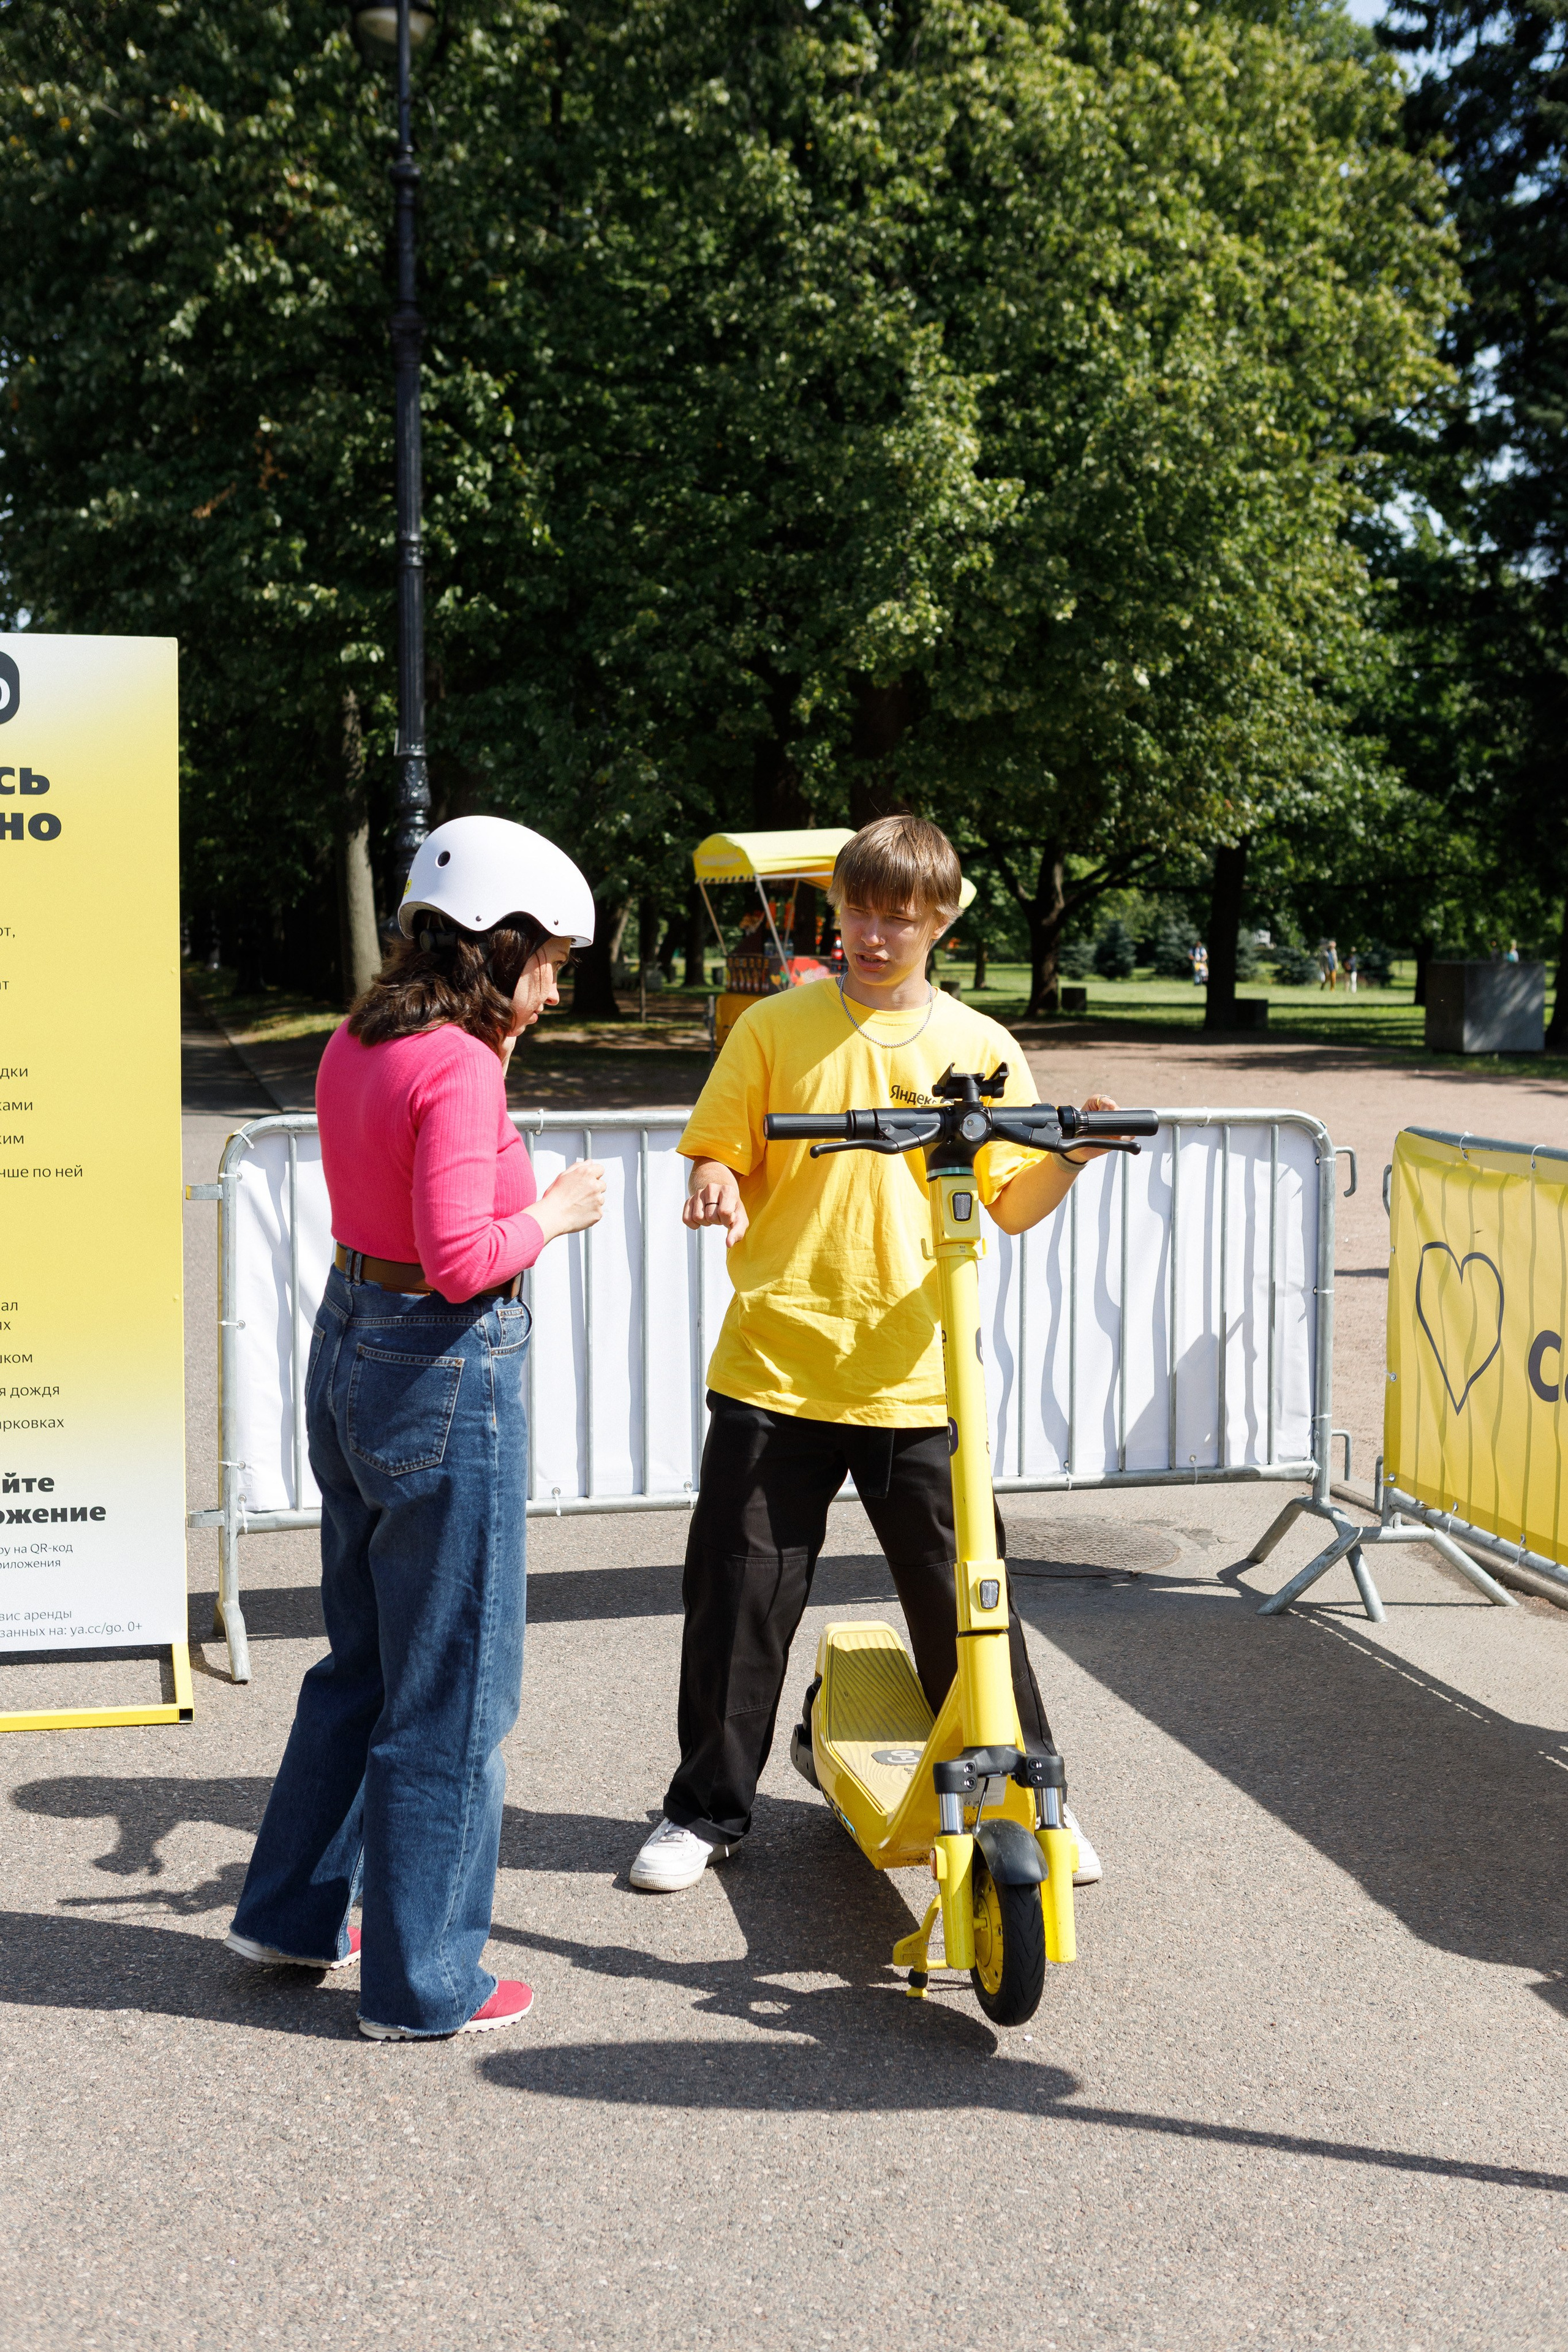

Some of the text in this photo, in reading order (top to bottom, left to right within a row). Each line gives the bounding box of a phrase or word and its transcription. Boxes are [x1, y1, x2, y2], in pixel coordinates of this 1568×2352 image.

[0, 1068, 28, 1080] дки
[0, 1101, 33, 1111] ами
[0, 1135, 24, 1145] им
[33, 1168, 51, 1178] по
[55, 1164, 83, 1177] ней
[1, 1302, 18, 1311] ал
[0, 1354, 32, 1363] ком
[1528, 1330, 1568, 1404] С
[10, 1386, 59, 1399] дождя
[0, 1419, 64, 1432] рковках
[2, 1472, 55, 1494] йте
[30, 1543, 73, 1555] QR-код
[24, 1611, 72, 1623] аренды
[70, 1623, 124, 1637] ya.cc/go.
[127, 1621, 142, 1632] 0+
